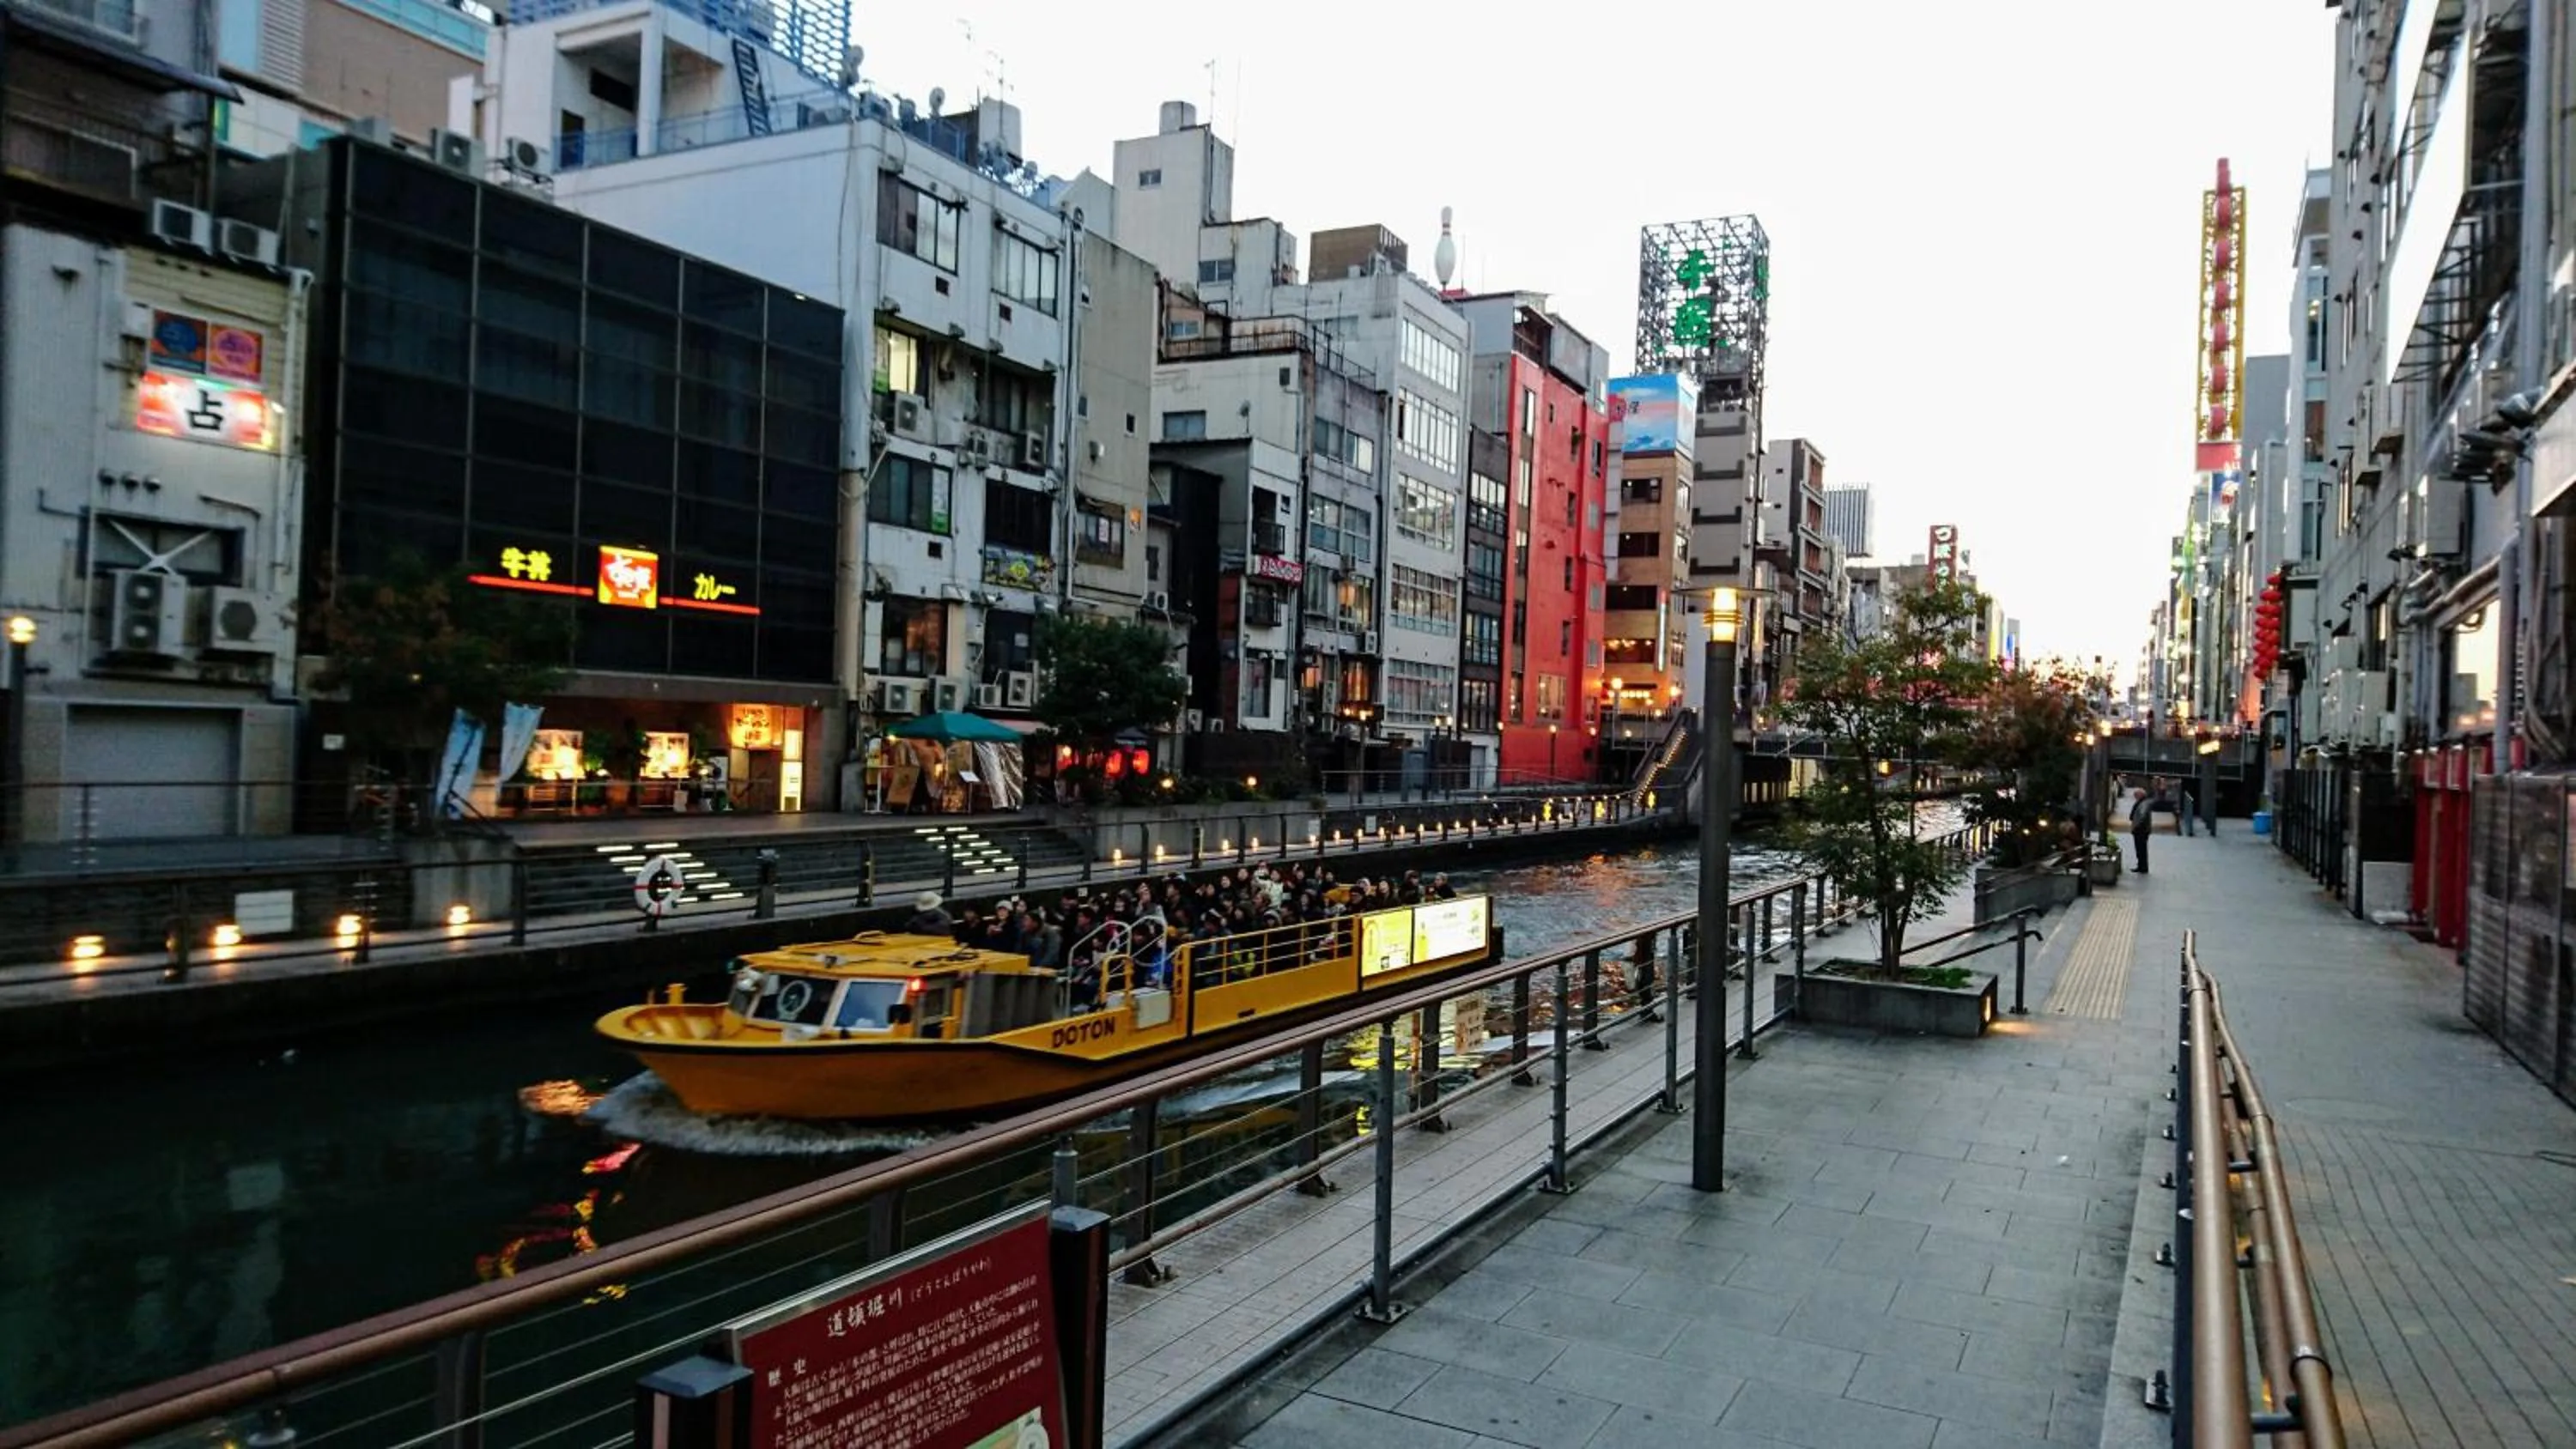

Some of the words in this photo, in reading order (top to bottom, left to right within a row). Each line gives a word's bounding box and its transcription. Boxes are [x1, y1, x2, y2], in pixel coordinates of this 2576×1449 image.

[186, 388, 224, 431] 占
[501, 547, 552, 581] 牛丼
[693, 572, 736, 601] カレー
[1051, 1016, 1116, 1048] DOTON
[826, 1287, 902, 1338] 道頓堀川
